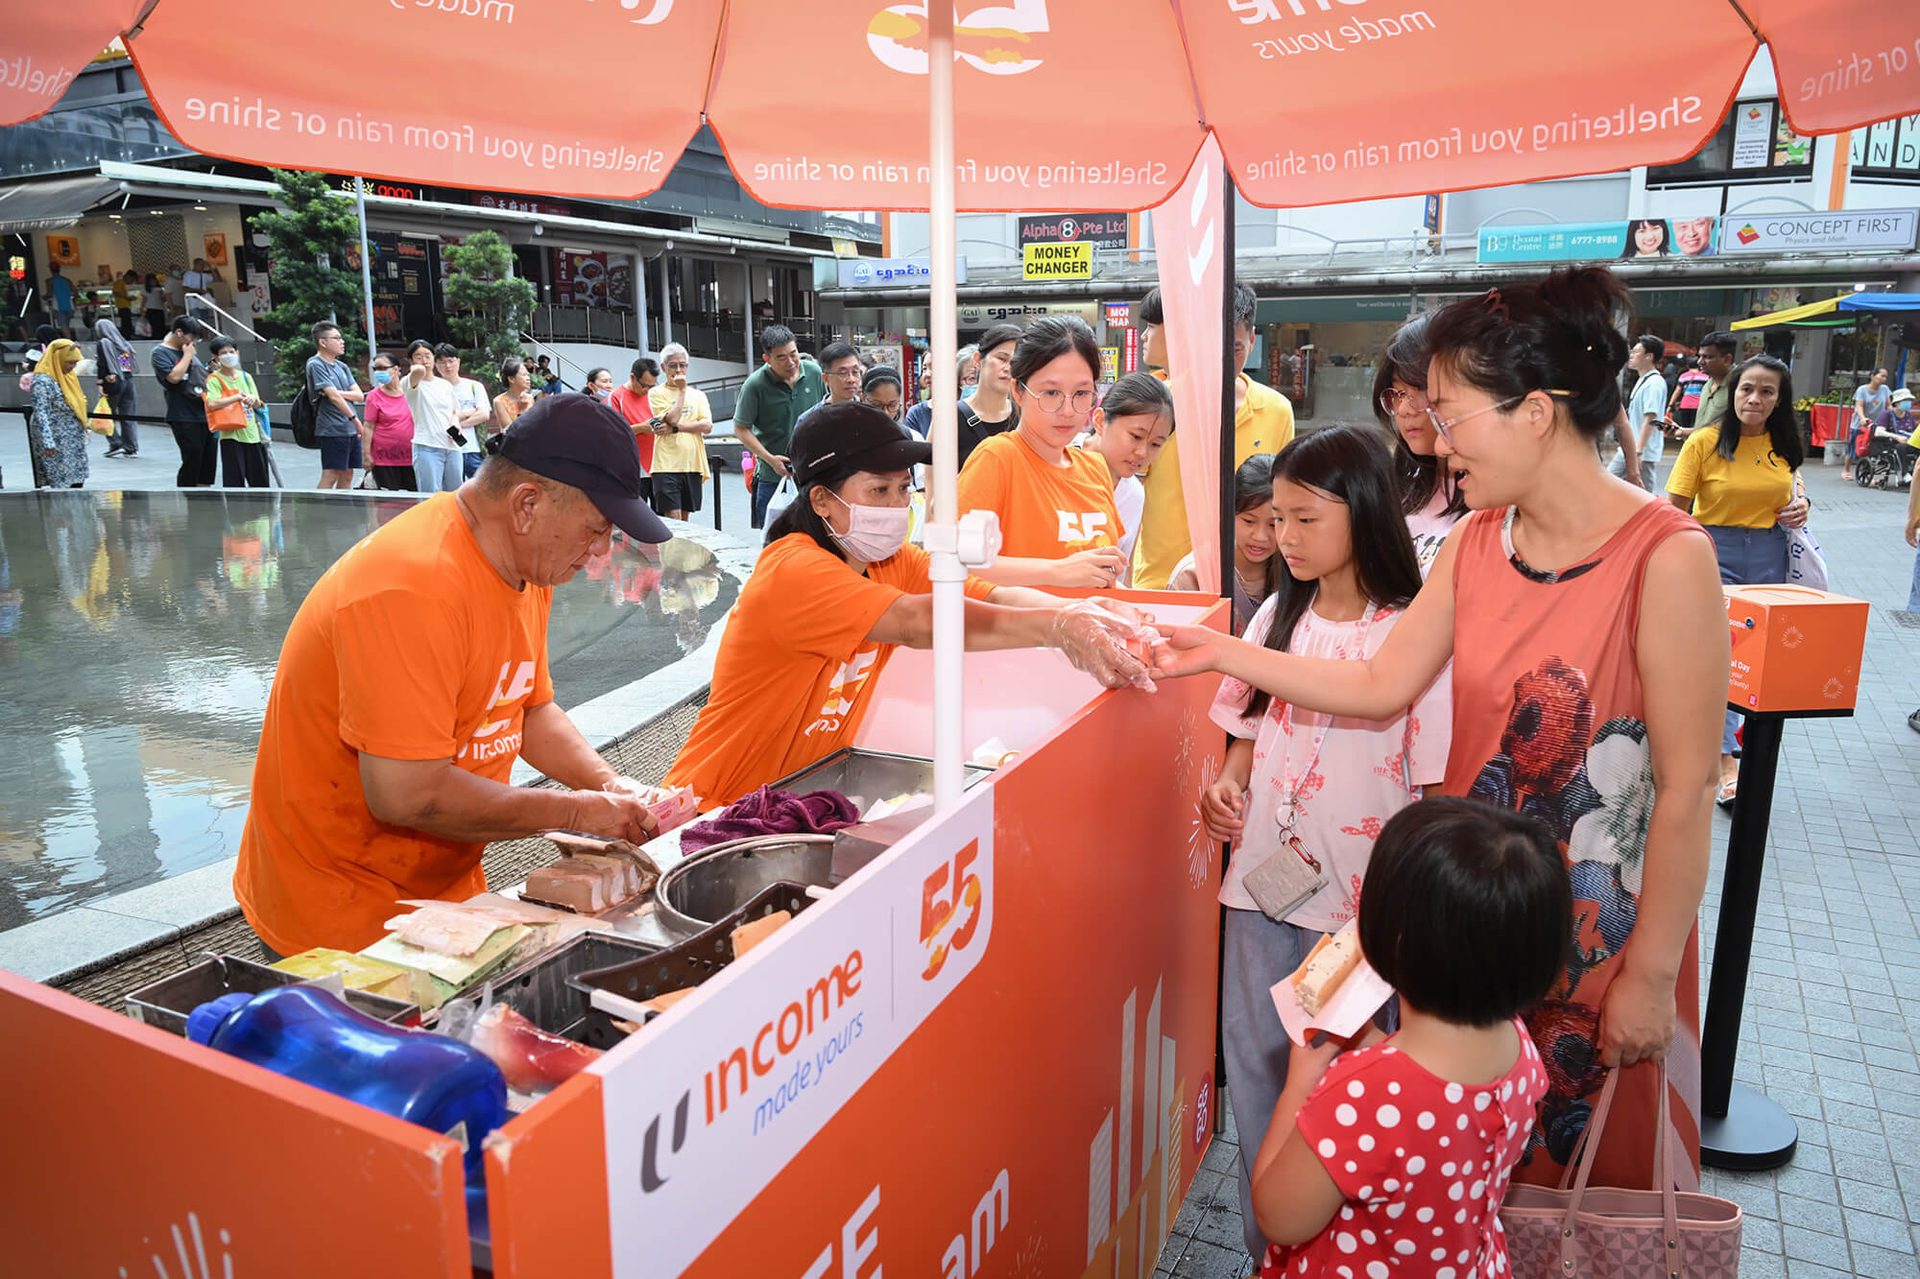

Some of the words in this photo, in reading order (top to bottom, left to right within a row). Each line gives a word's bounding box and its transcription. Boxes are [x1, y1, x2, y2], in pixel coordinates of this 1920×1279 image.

[1022, 223, 1057, 240] Alpha
[1083, 222, 1103, 234] Pte
[1106, 219, 1126, 233] Ltd
[1766, 219, 1852, 237] CONCEPT
[1857, 217, 1902, 233] FIRST
[1512, 233, 1543, 243] Dental
[1785, 236, 1810, 244] Physics
[1034, 246, 1080, 259] MONEY
[1512, 243, 1542, 251] Centre
[1026, 261, 1088, 274] CHANGER
[919, 837, 982, 981] 55
[753, 1060, 811, 1136] made
[813, 1011, 864, 1086] yours
